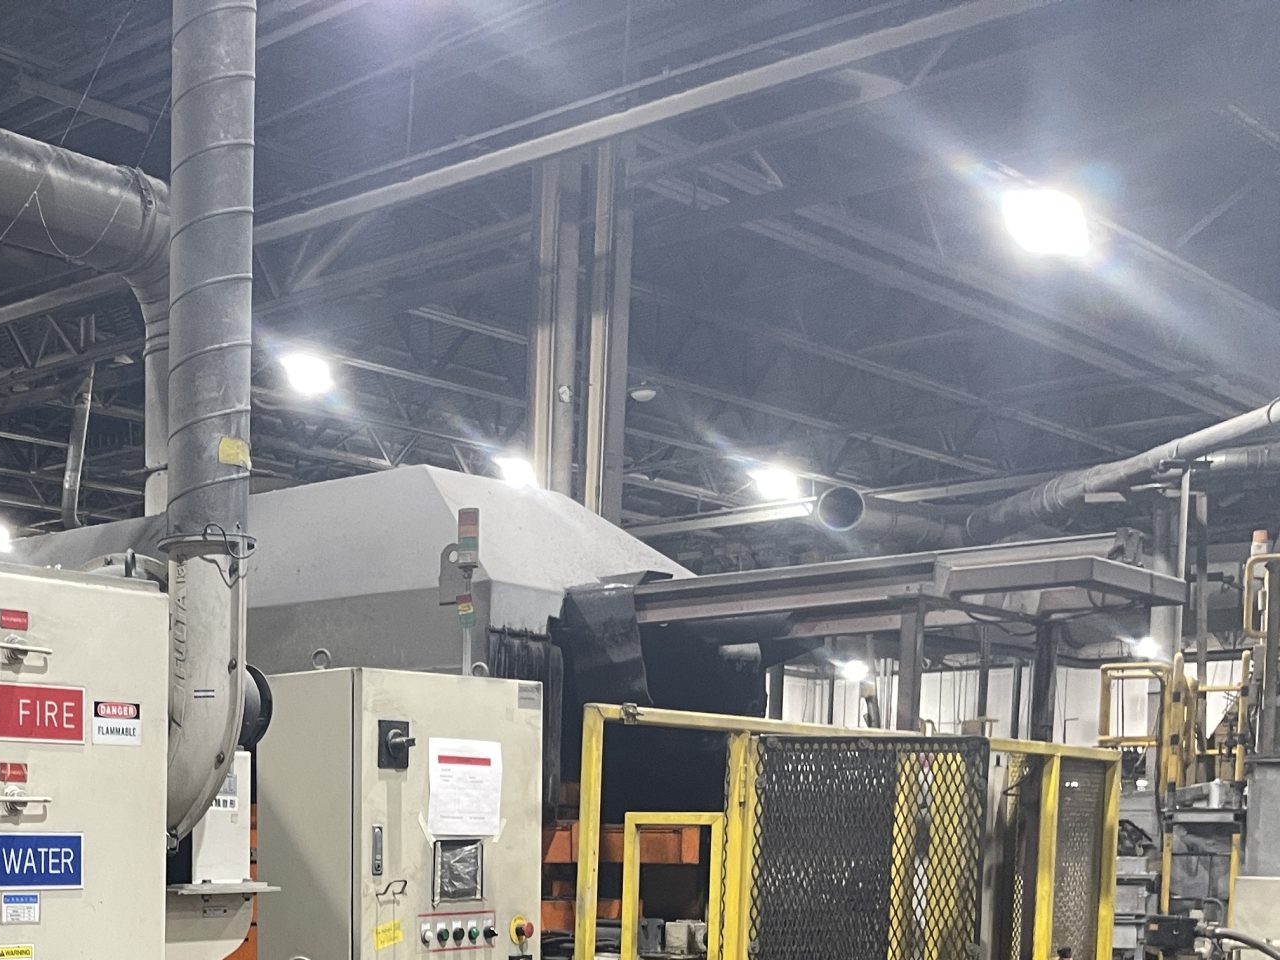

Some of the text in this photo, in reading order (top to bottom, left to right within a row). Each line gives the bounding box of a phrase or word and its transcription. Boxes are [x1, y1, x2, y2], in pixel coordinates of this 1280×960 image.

[19, 699, 75, 728] FIRE
[99, 704, 135, 716] DANGER
[97, 725, 136, 737] FLAMMABLE
[2, 847, 74, 874] WATER
